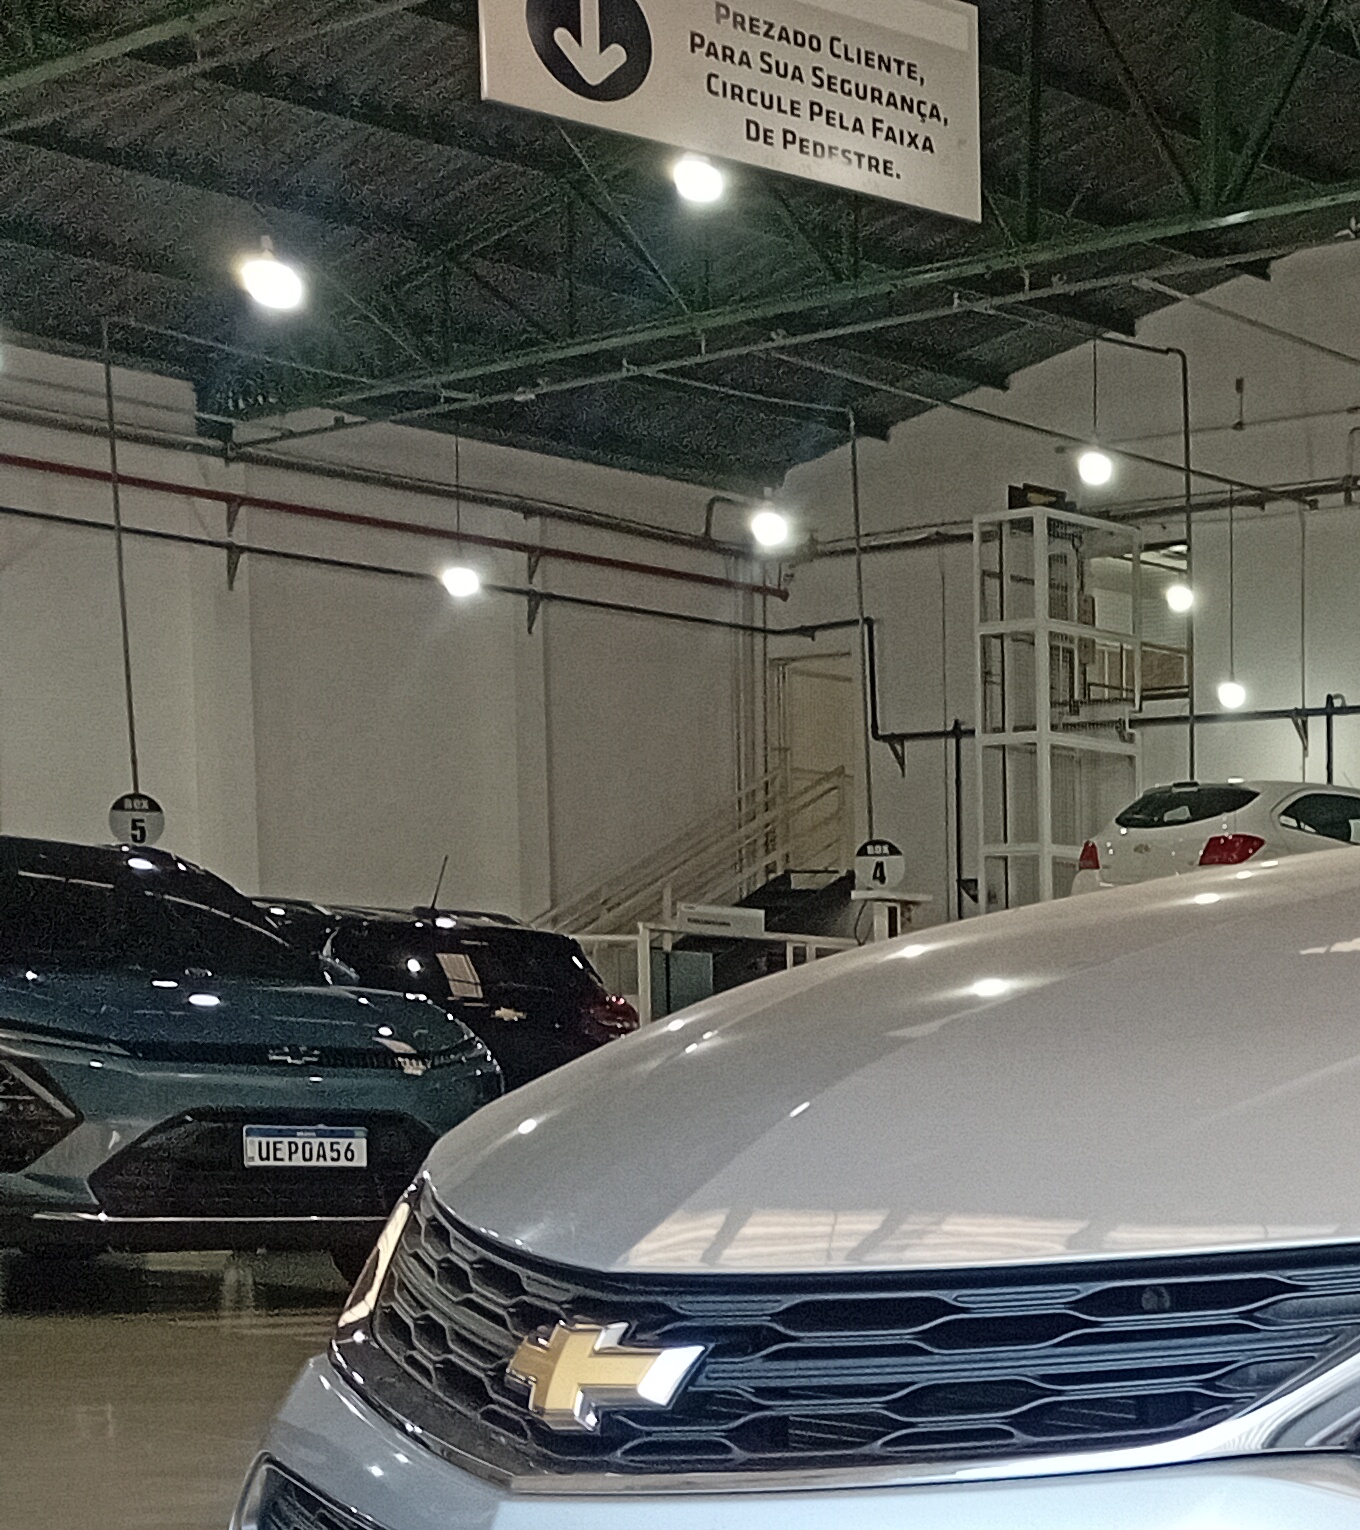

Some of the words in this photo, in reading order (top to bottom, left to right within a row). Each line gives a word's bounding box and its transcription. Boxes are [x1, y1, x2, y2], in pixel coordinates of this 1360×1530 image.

[689, 30, 753, 70] PARA
[760, 51, 805, 84] SUA
[811, 66, 949, 127] SEGURANÇA,
[715, 1, 822, 53] PREZADO
[829, 36, 925, 86] CLIENTE,
[706, 72, 802, 118] CIRCULE
[809, 100, 866, 135] PELA
[872, 117, 935, 155] FAIXA
[745, 118, 775, 147] DE
[782, 128, 902, 180] PEDESTRE.
[131, 818, 146, 844] 5
[872, 860, 886, 885] 4
